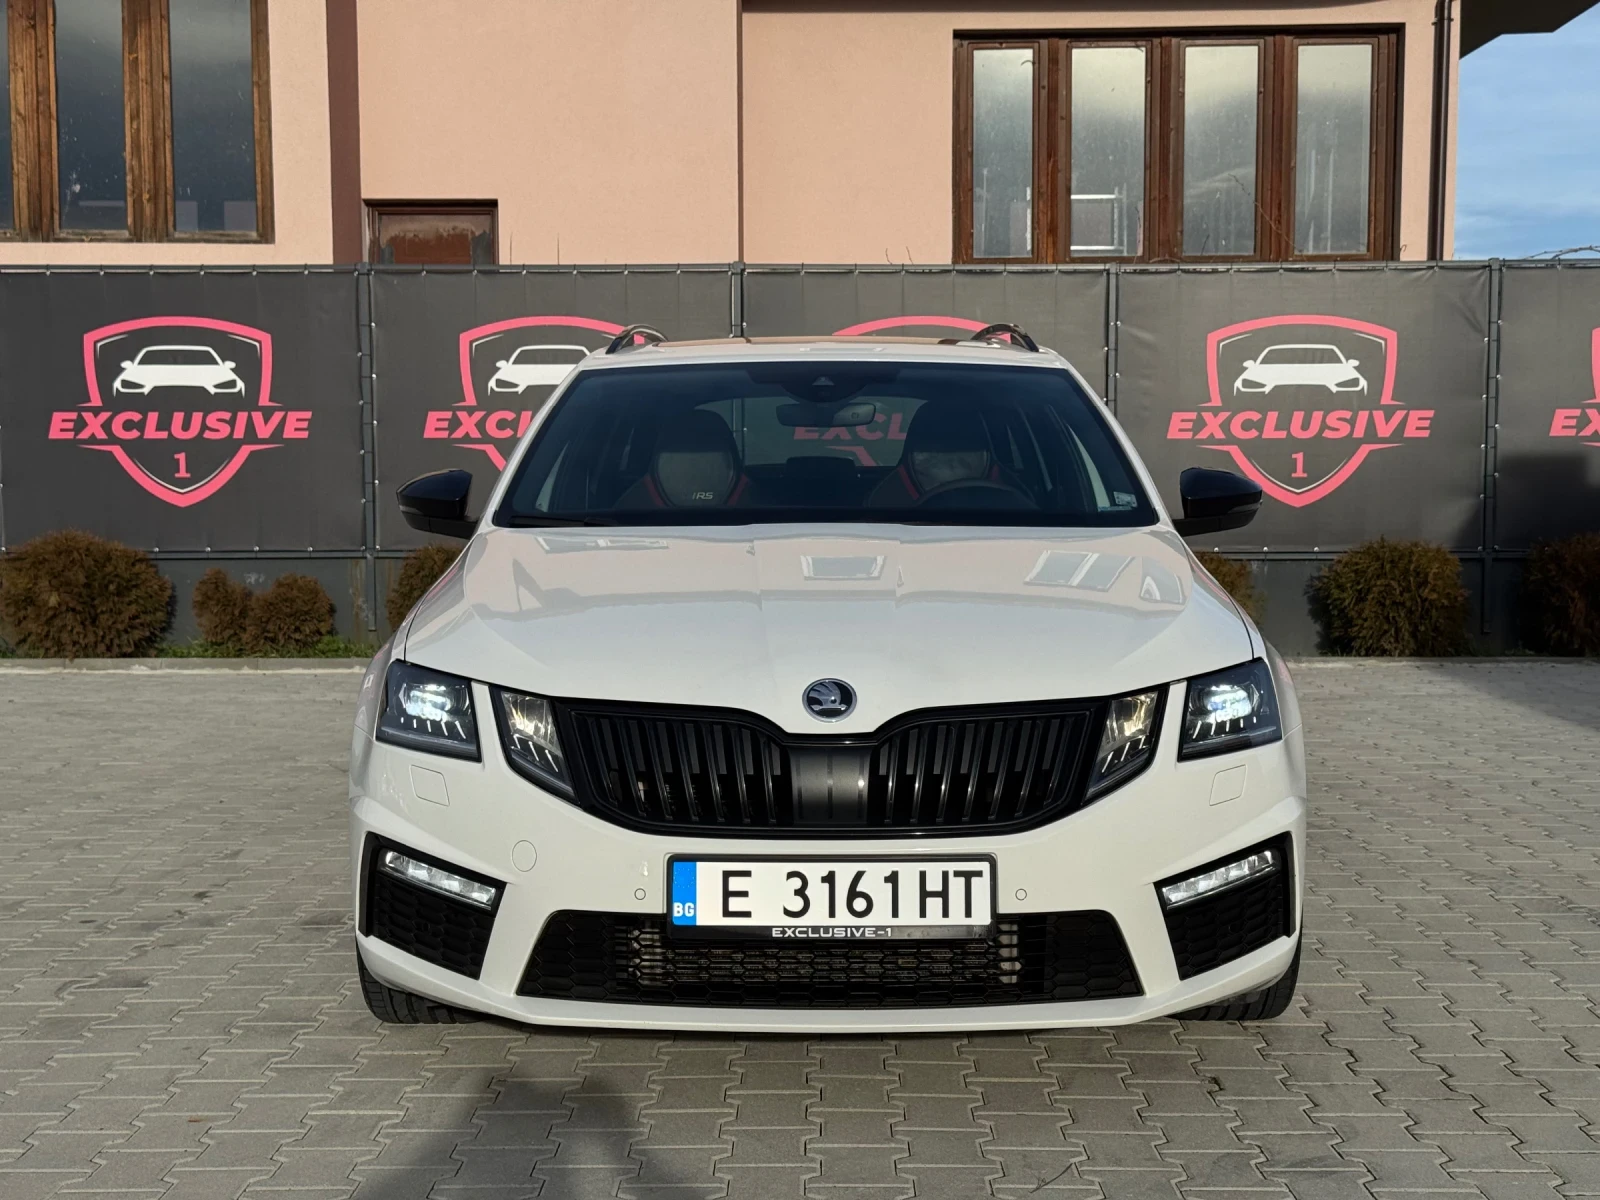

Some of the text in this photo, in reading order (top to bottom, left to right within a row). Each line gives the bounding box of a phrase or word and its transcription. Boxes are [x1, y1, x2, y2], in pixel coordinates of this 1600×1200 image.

[48, 411, 312, 440] EXCLUSIVE
[1166, 409, 1435, 439] EXCLUSIVE
[174, 452, 191, 478] 1
[1291, 452, 1308, 477] 1
[722, 870, 752, 918] E
[673, 902, 695, 918] BG
[771, 927, 892, 939] EXCLUSIVE-1
